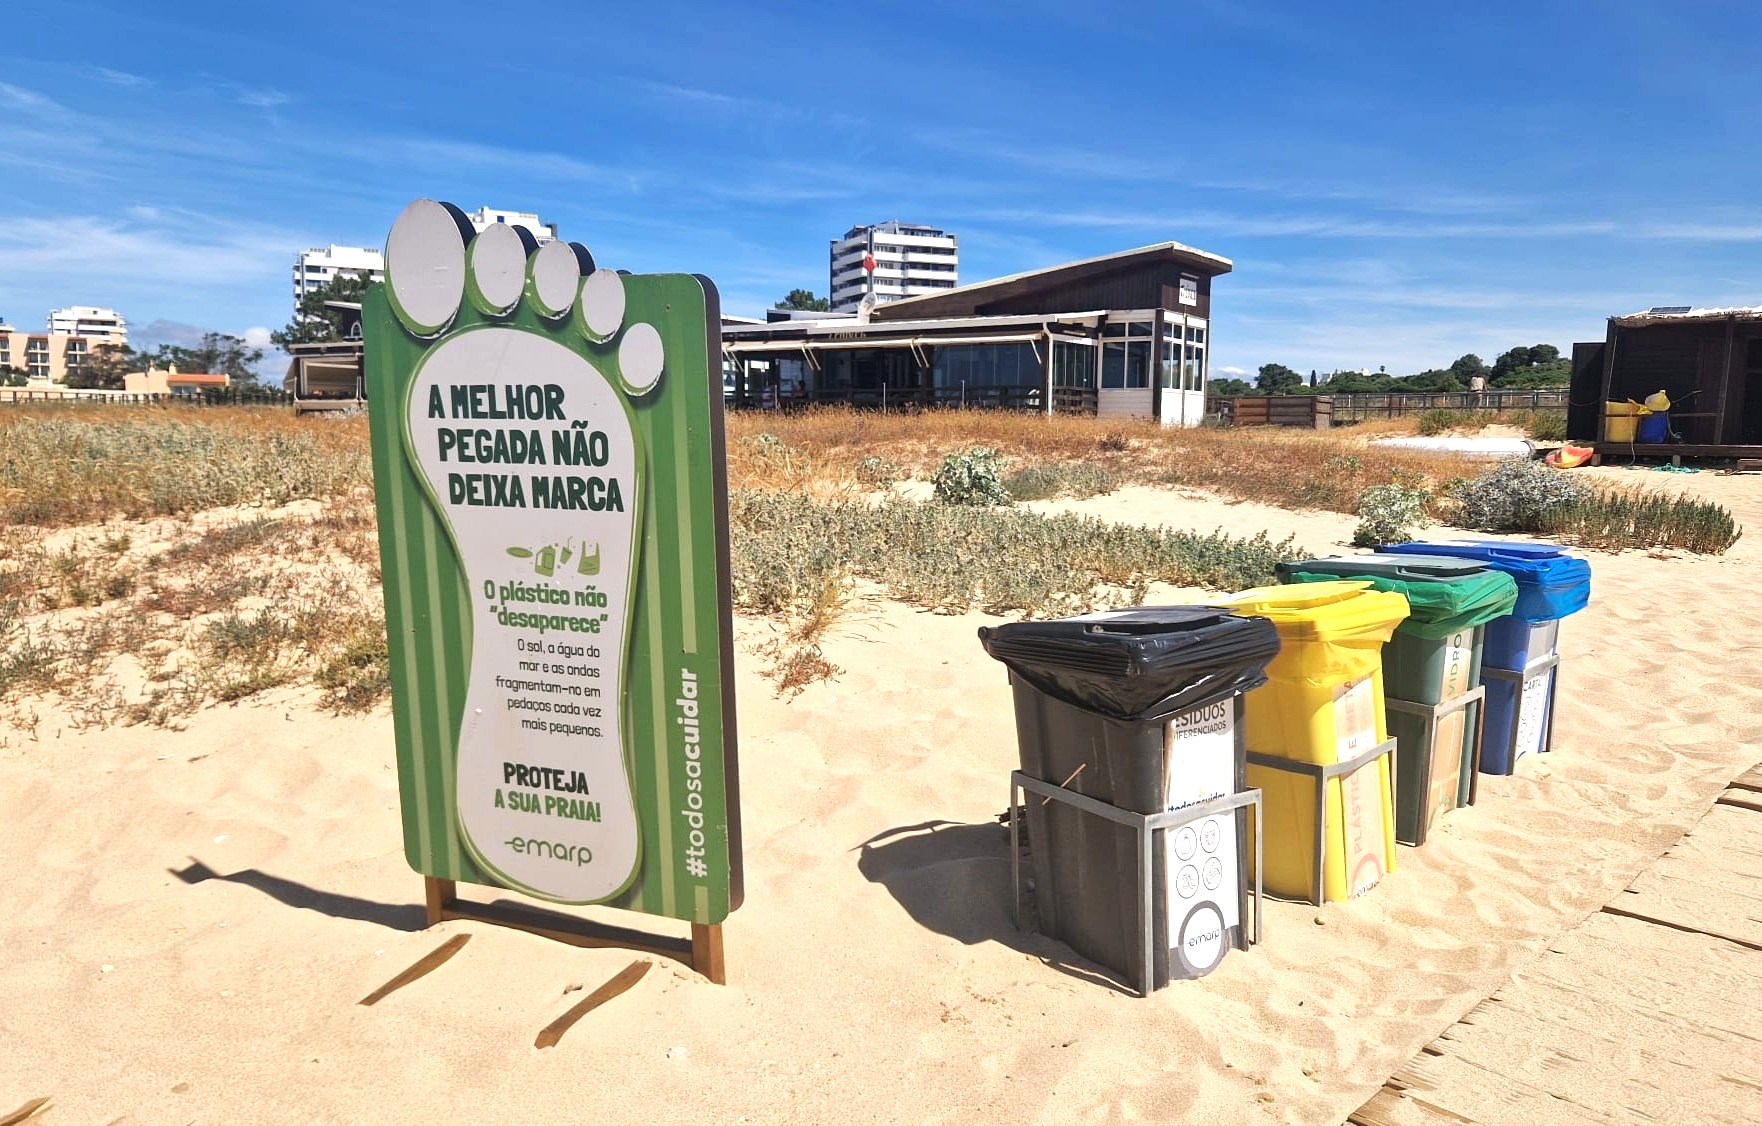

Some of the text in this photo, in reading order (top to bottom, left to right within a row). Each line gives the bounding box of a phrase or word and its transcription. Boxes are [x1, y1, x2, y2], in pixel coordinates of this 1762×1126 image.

[428, 384, 566, 420] A MELHOR
[438, 420, 609, 467] PEGADA NÃO
[448, 473, 625, 513] DEIXA MARCA
[484, 579, 608, 608] O plástico não
[517, 638, 600, 659] O sol, a água do
[519, 660, 600, 678] mar e as ondas
[1448, 634, 1462, 697] VIDRO
[495, 675, 601, 698] fragmentam-no em
[507, 697, 602, 718] pedaços cada vez
[521, 717, 604, 738] mais pequenos.
[503, 762, 589, 796] PROTEJA
[676, 668, 708, 878] #todosacuidar
[494, 788, 602, 823] A SUA PRAIA!
[504, 836, 593, 867] emarp
